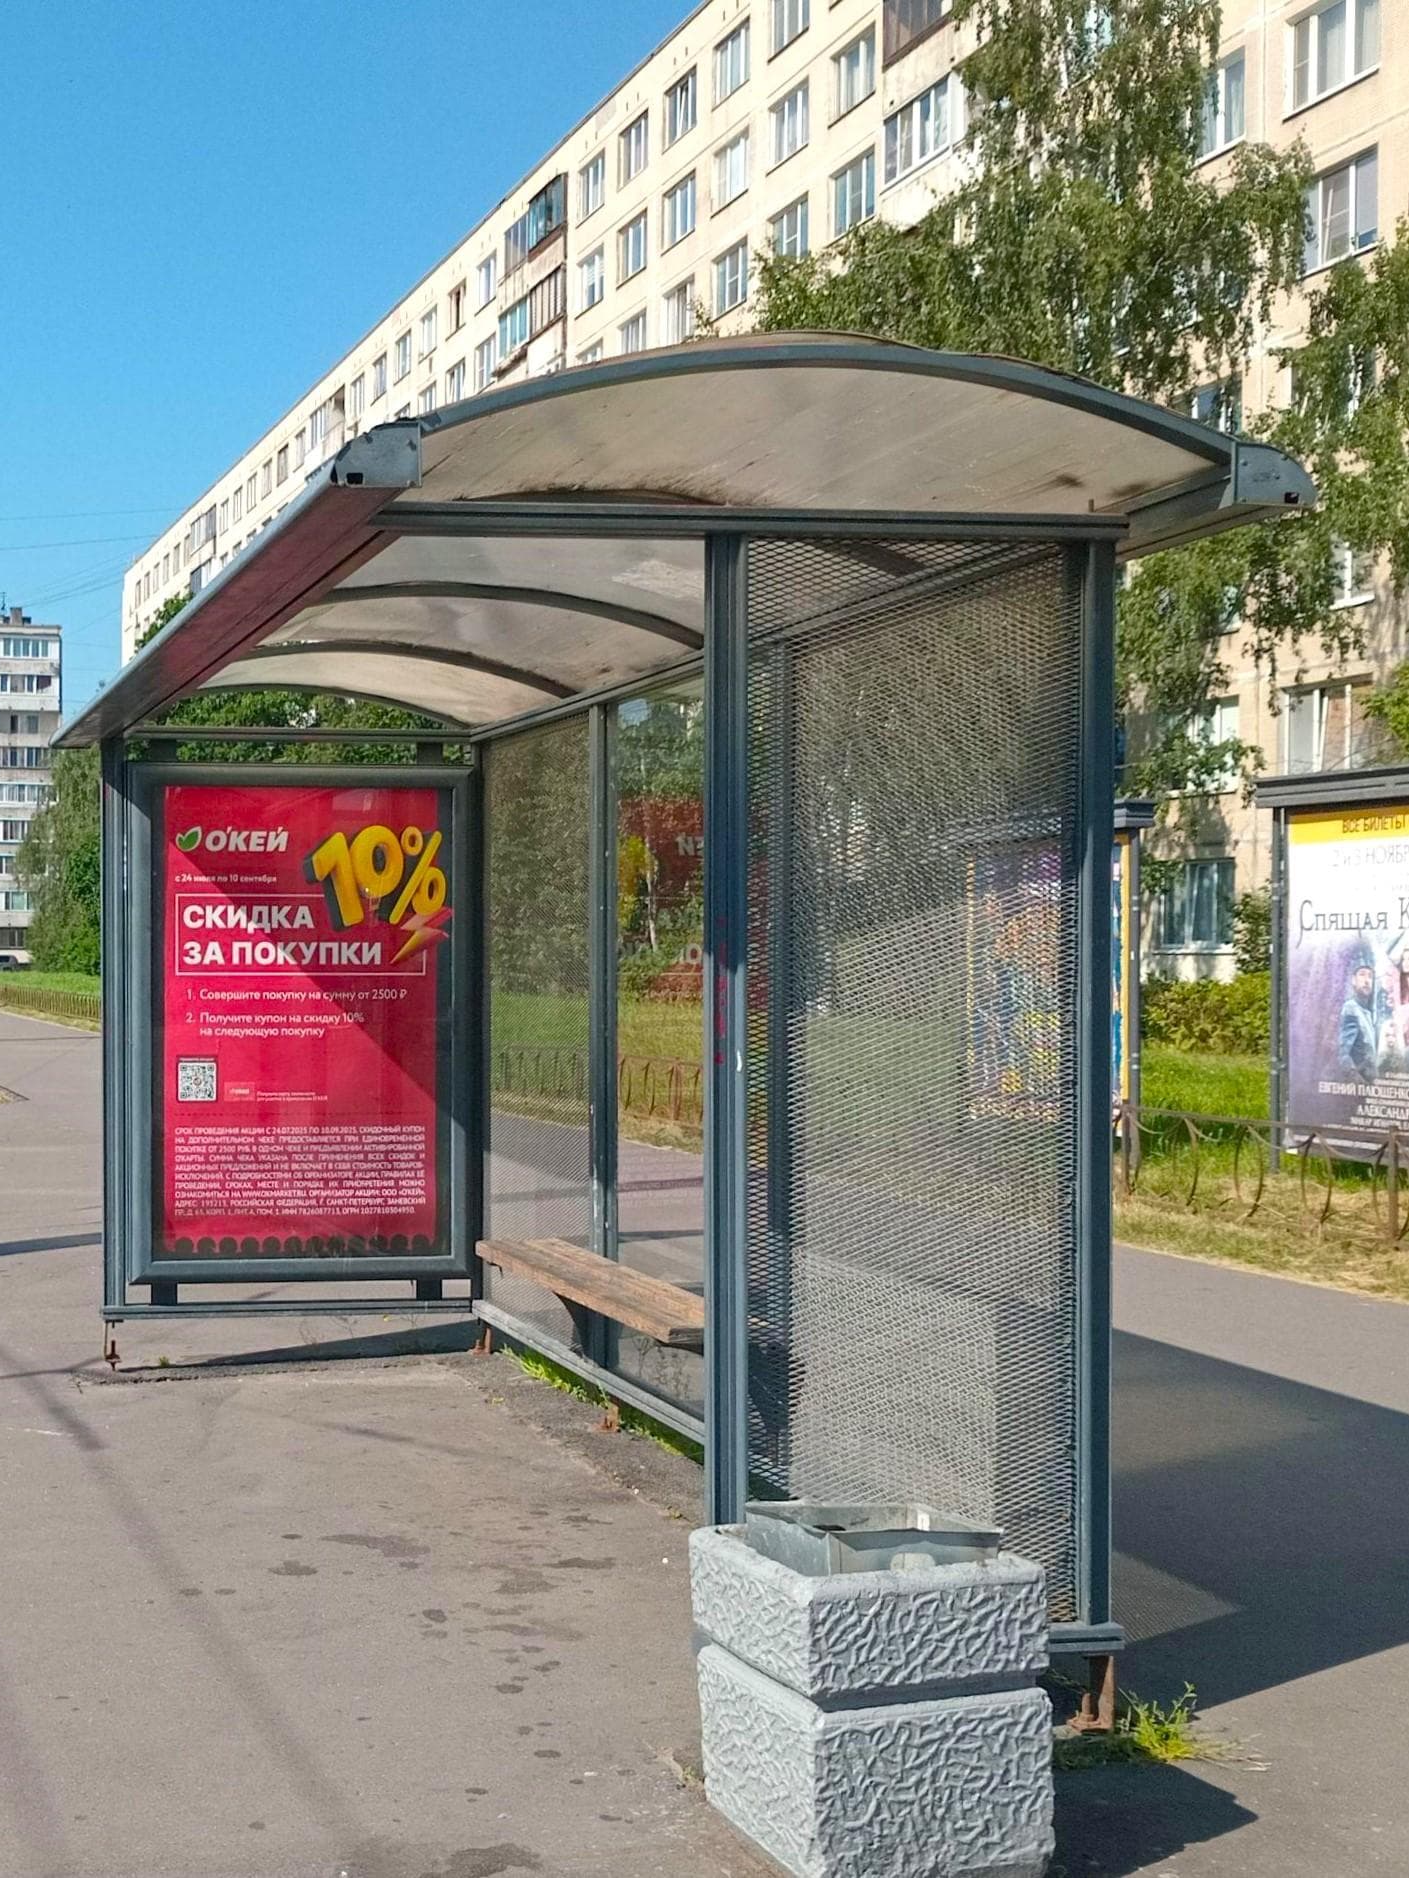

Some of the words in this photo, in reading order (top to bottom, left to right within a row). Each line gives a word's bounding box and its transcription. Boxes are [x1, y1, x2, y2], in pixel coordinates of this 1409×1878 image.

[181, 873, 192, 882] 24
[229, 873, 238, 882] 10
[240, 873, 277, 884] сентября
[310, 825, 446, 927] 10%
[183, 905, 315, 933] СКИДКА
[183, 941, 225, 965] ЗА
[232, 941, 381, 965] ПОКУПКИ
[199, 989, 261, 1002] Совершите
[263, 991, 306, 1002] покупку
[308, 991, 321, 1000] на
[322, 991, 356, 1002] сумму
[357, 991, 370, 1000] от
[372, 989, 397, 1000] 2500
[199, 1012, 253, 1025] Получите
[254, 1014, 287, 1025] купон
[289, 1014, 301, 1022] на
[303, 1014, 340, 1025] скидку
[342, 1012, 364, 1022] 10%
[200, 1028, 213, 1036] на
[214, 1028, 278, 1038] следующую
[281, 1028, 325, 1038] покупку
